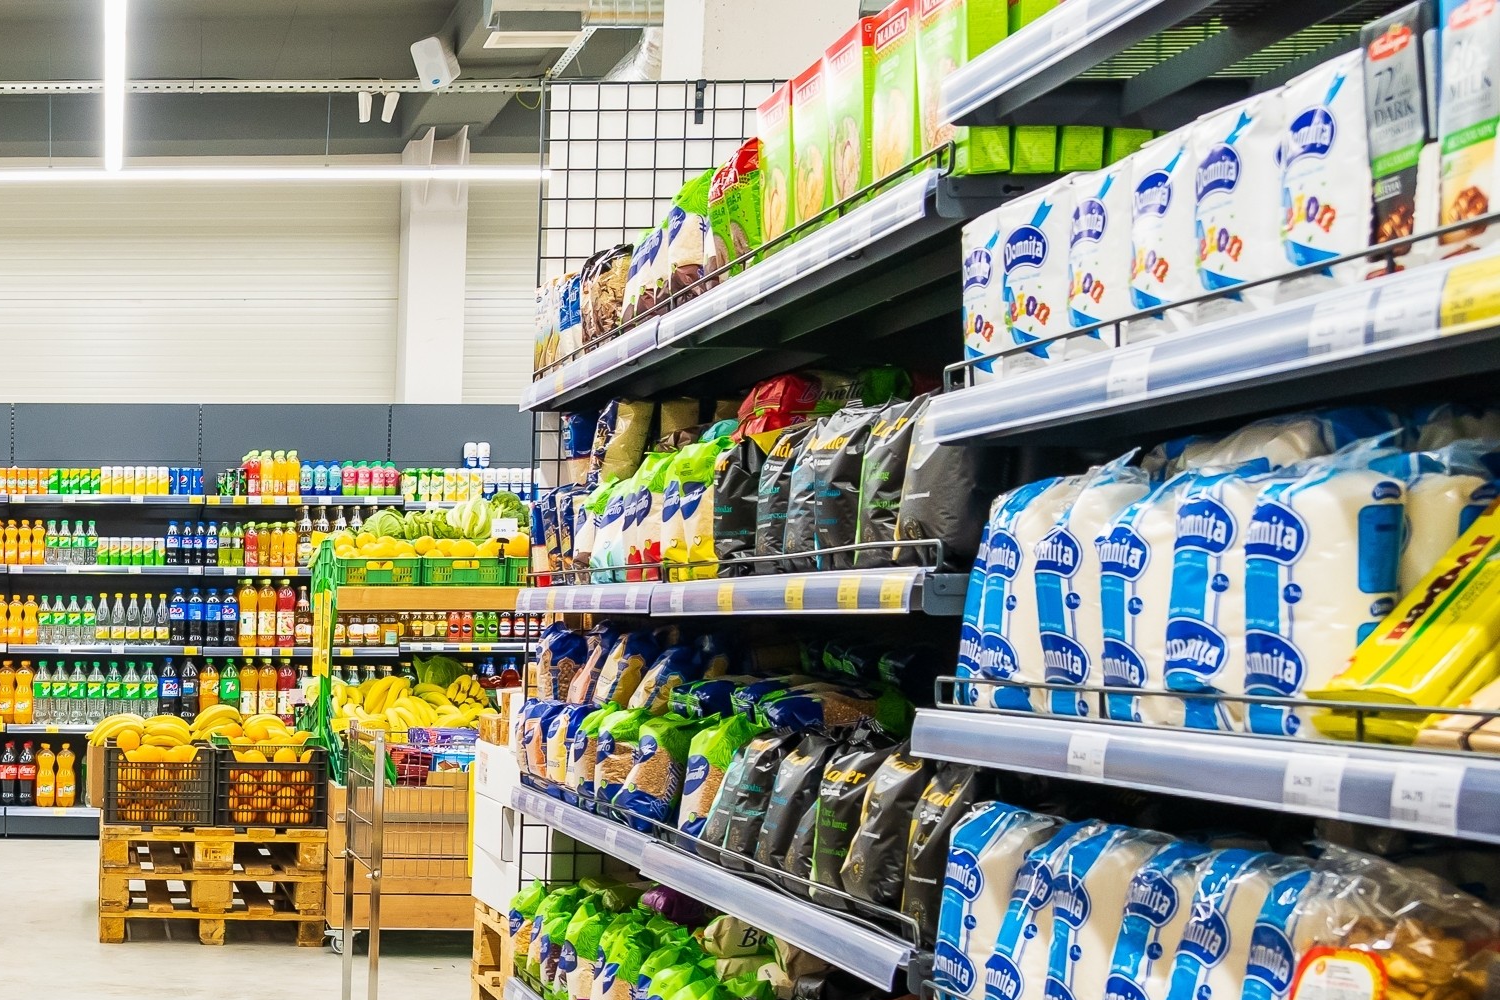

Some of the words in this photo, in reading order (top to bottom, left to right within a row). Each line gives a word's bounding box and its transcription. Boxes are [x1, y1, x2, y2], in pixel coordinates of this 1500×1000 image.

[876, 11, 908, 48] MAKFA
[1374, 100, 1416, 124] DARK
[1006, 236, 1044, 265] Domnița
[1246, 516, 1299, 552] mnița
[992, 543, 1016, 571] mnița
[1036, 538, 1074, 567] mnița
[1098, 538, 1144, 570] mnița
[1045, 646, 1082, 676] mnița
[1103, 653, 1140, 686] mnița
[1246, 650, 1297, 685] mnița
[947, 861, 977, 893] mnița
[1053, 888, 1082, 921] mnița
[935, 952, 970, 986] mnița
[1251, 945, 1290, 984] mnița
[985, 966, 1017, 1000] mnița
